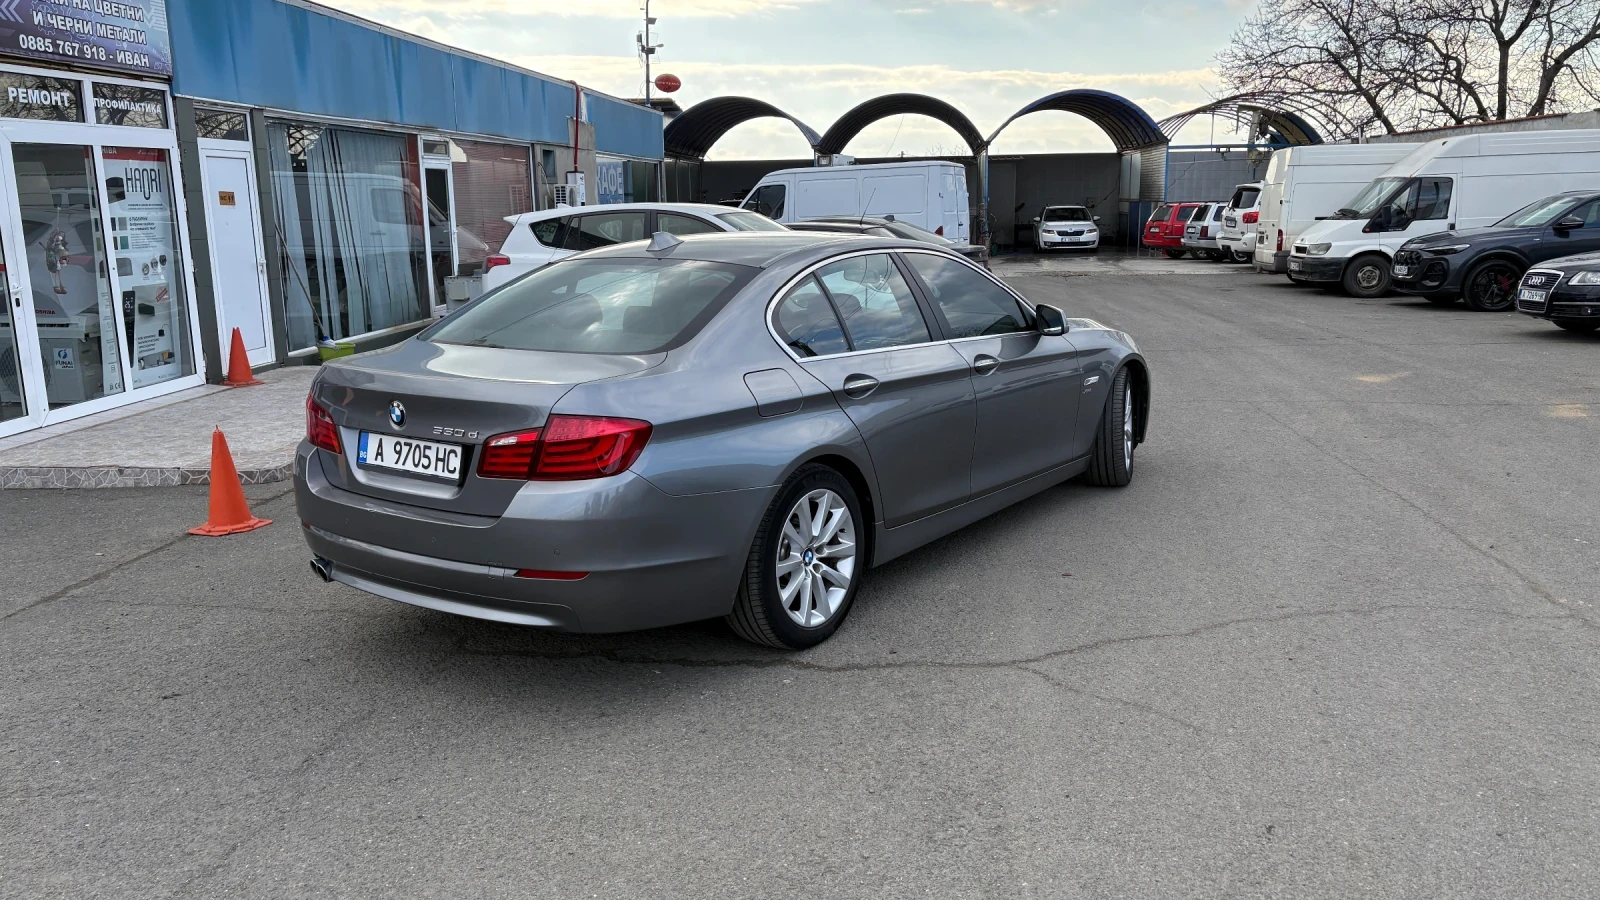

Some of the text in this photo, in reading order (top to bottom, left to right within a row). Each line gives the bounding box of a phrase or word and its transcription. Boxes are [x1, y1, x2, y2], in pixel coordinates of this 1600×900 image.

[73, 0, 145, 22] НА ЦВЕТНИ
[33, 10, 147, 45] И ЧЕРНИ МЕТАЛИ
[19, 34, 53, 53] 0885
[56, 40, 80, 56] 767
[83, 44, 106, 61] 918
[116, 49, 150, 68] ИВАН
[8, 87, 70, 107] РЕМОНТ
[94, 98, 162, 114] ПРОФИЛАКТИКА
[102, 146, 117, 155] HIBA
[124, 167, 162, 200] HAORI
[359, 450, 367, 459] BG
[374, 437, 458, 474] A 9705 HC
